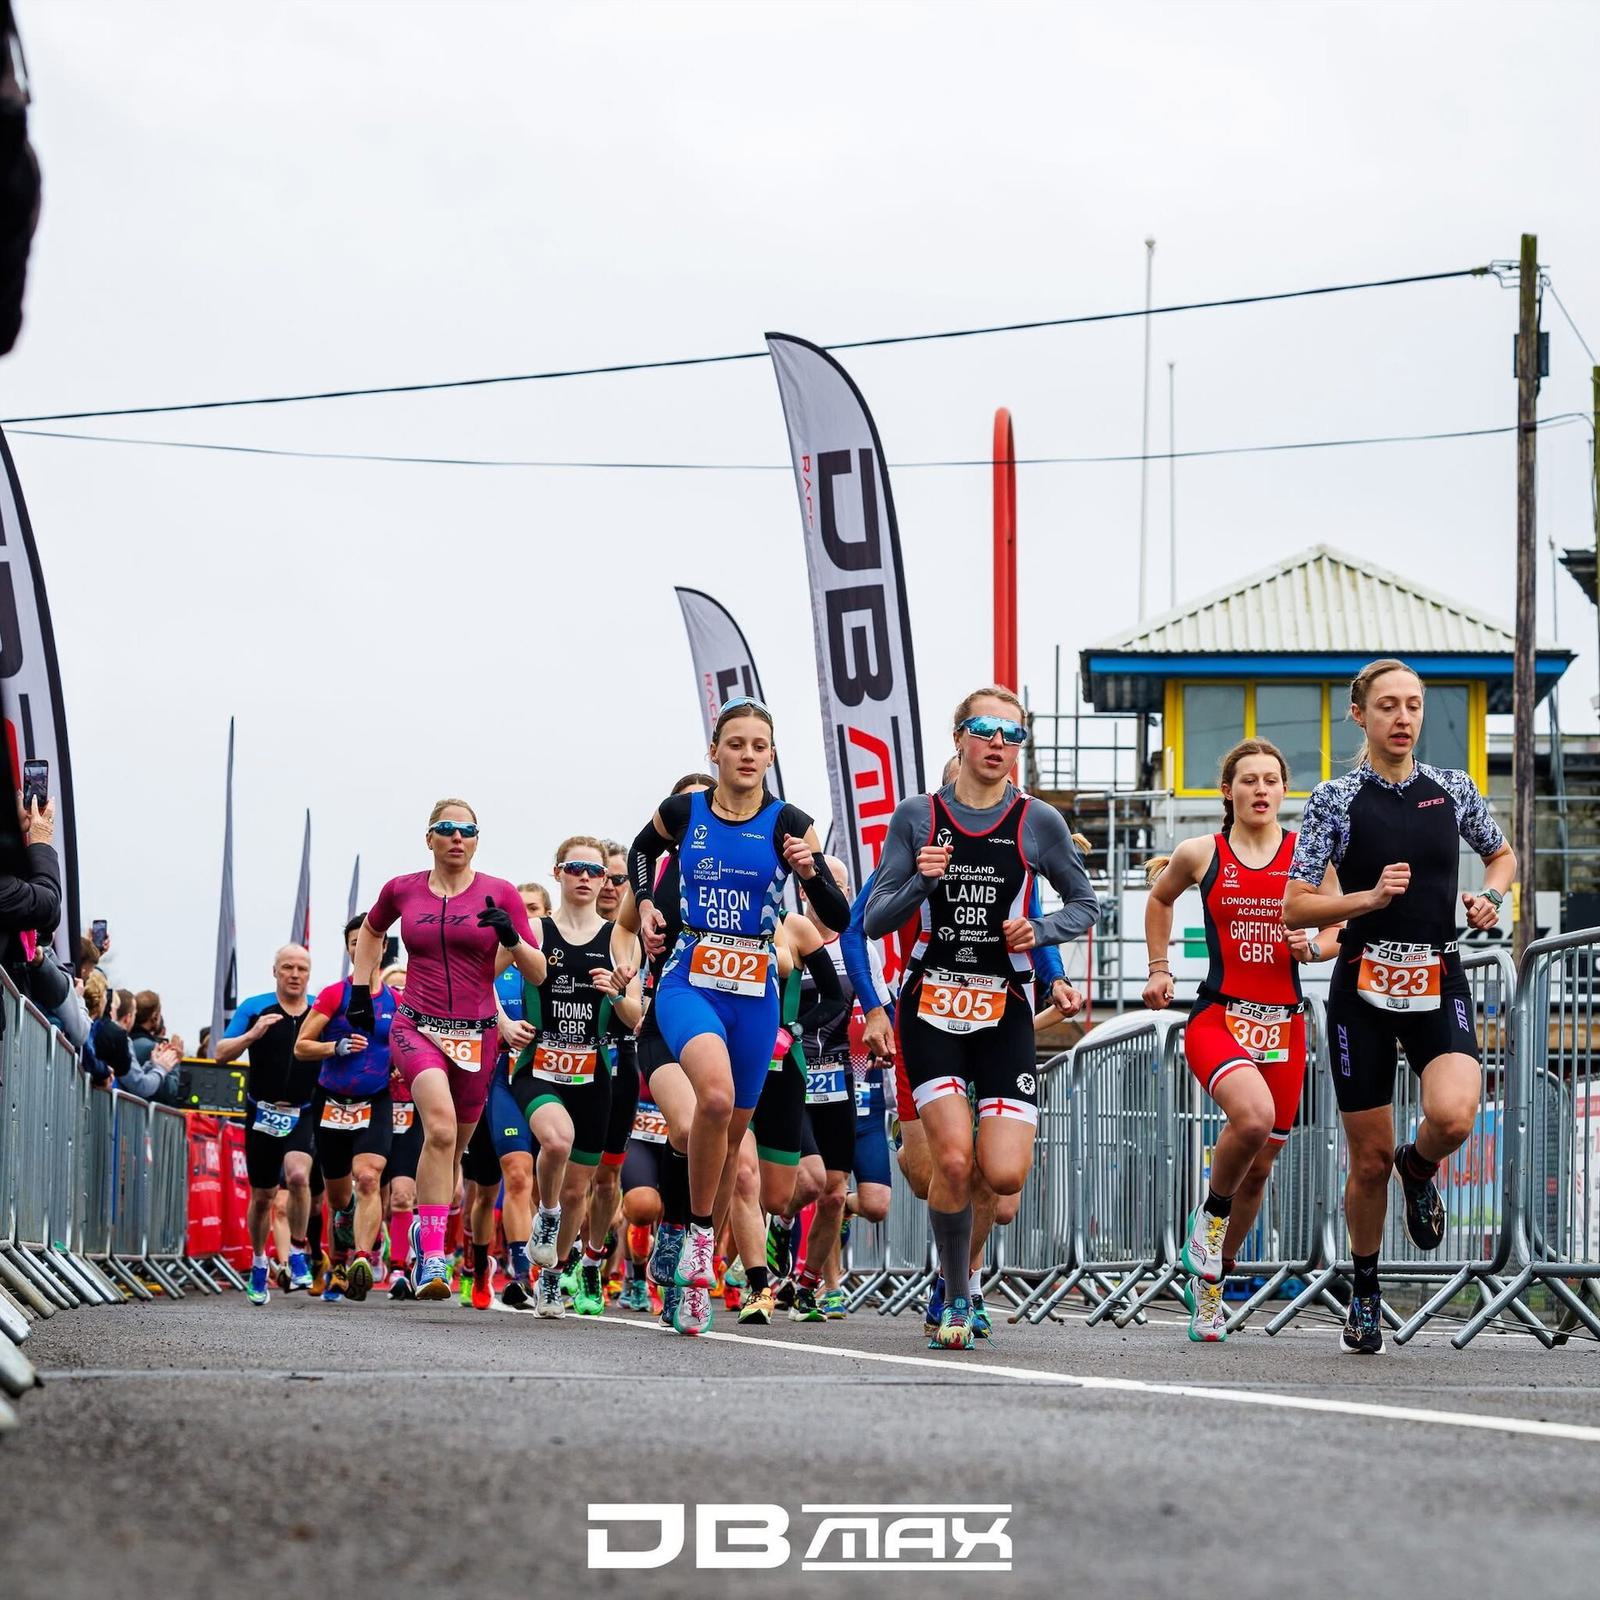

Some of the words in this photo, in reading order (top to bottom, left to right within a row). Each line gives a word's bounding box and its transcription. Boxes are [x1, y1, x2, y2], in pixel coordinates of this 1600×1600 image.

[817, 447, 894, 707] DB
[949, 864, 995, 875] ENGLAND
[960, 874, 1005, 884] GENERATION
[698, 886, 750, 911] EATON
[945, 884, 997, 904] LAMB
[1221, 896, 1258, 907] LONDON
[706, 907, 742, 931] GBR
[954, 905, 988, 926] GBR
[1237, 907, 1279, 917] ACADEMY
[959, 929, 989, 937] SPORT
[1230, 920, 1283, 943] GRIFFITHS
[1239, 941, 1275, 964] GBR
[702, 949, 758, 981] 302
[1369, 965, 1429, 996] 323
[552, 1001, 593, 1020] THOMAS
[931, 988, 993, 1020] 305
[420, 1014, 469, 1029] SUNDRIED
[558, 1019, 586, 1035] GBR
[1232, 1020, 1281, 1049] 308
[542, 1051, 588, 1074] 307
[806, 1072, 837, 1093] 221
[261, 1111, 292, 1130] 229
[329, 1108, 363, 1124] 351
[634, 1115, 667, 1135] 327
